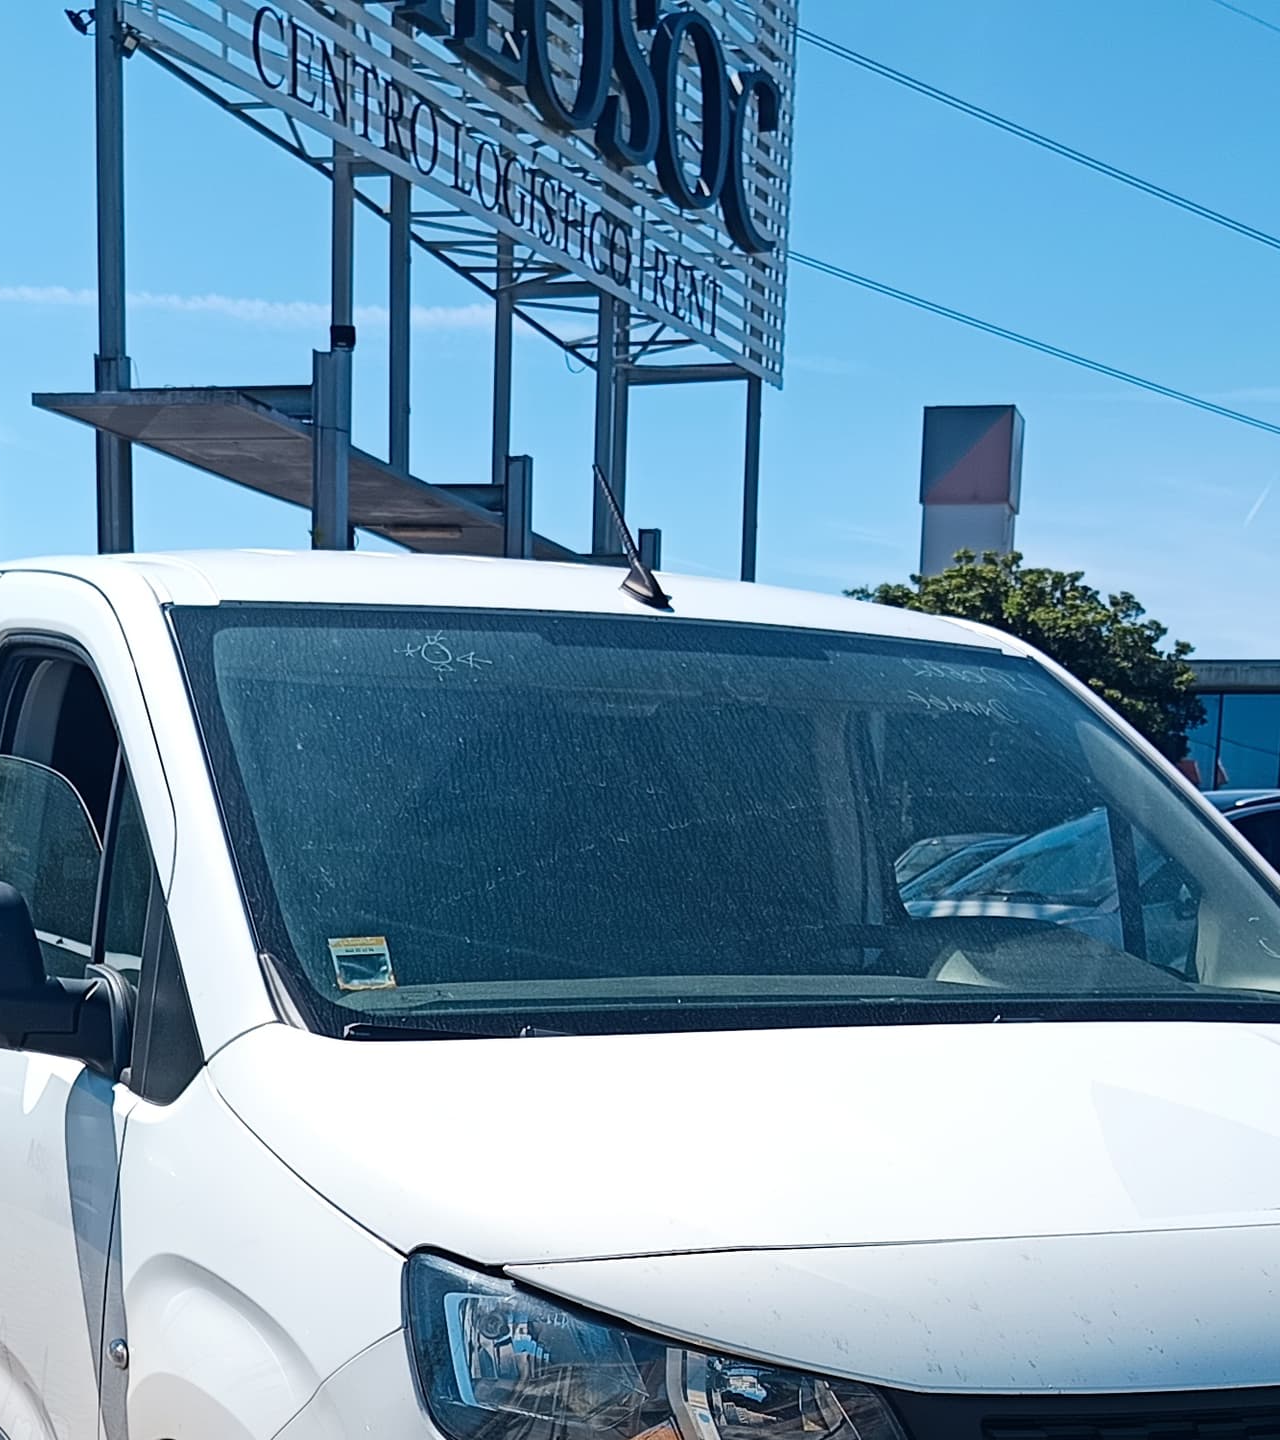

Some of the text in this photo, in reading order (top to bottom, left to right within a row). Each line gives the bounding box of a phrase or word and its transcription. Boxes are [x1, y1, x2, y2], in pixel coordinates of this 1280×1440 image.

[252, 6, 723, 338] CENTRO LOGÍSTICO RENT
